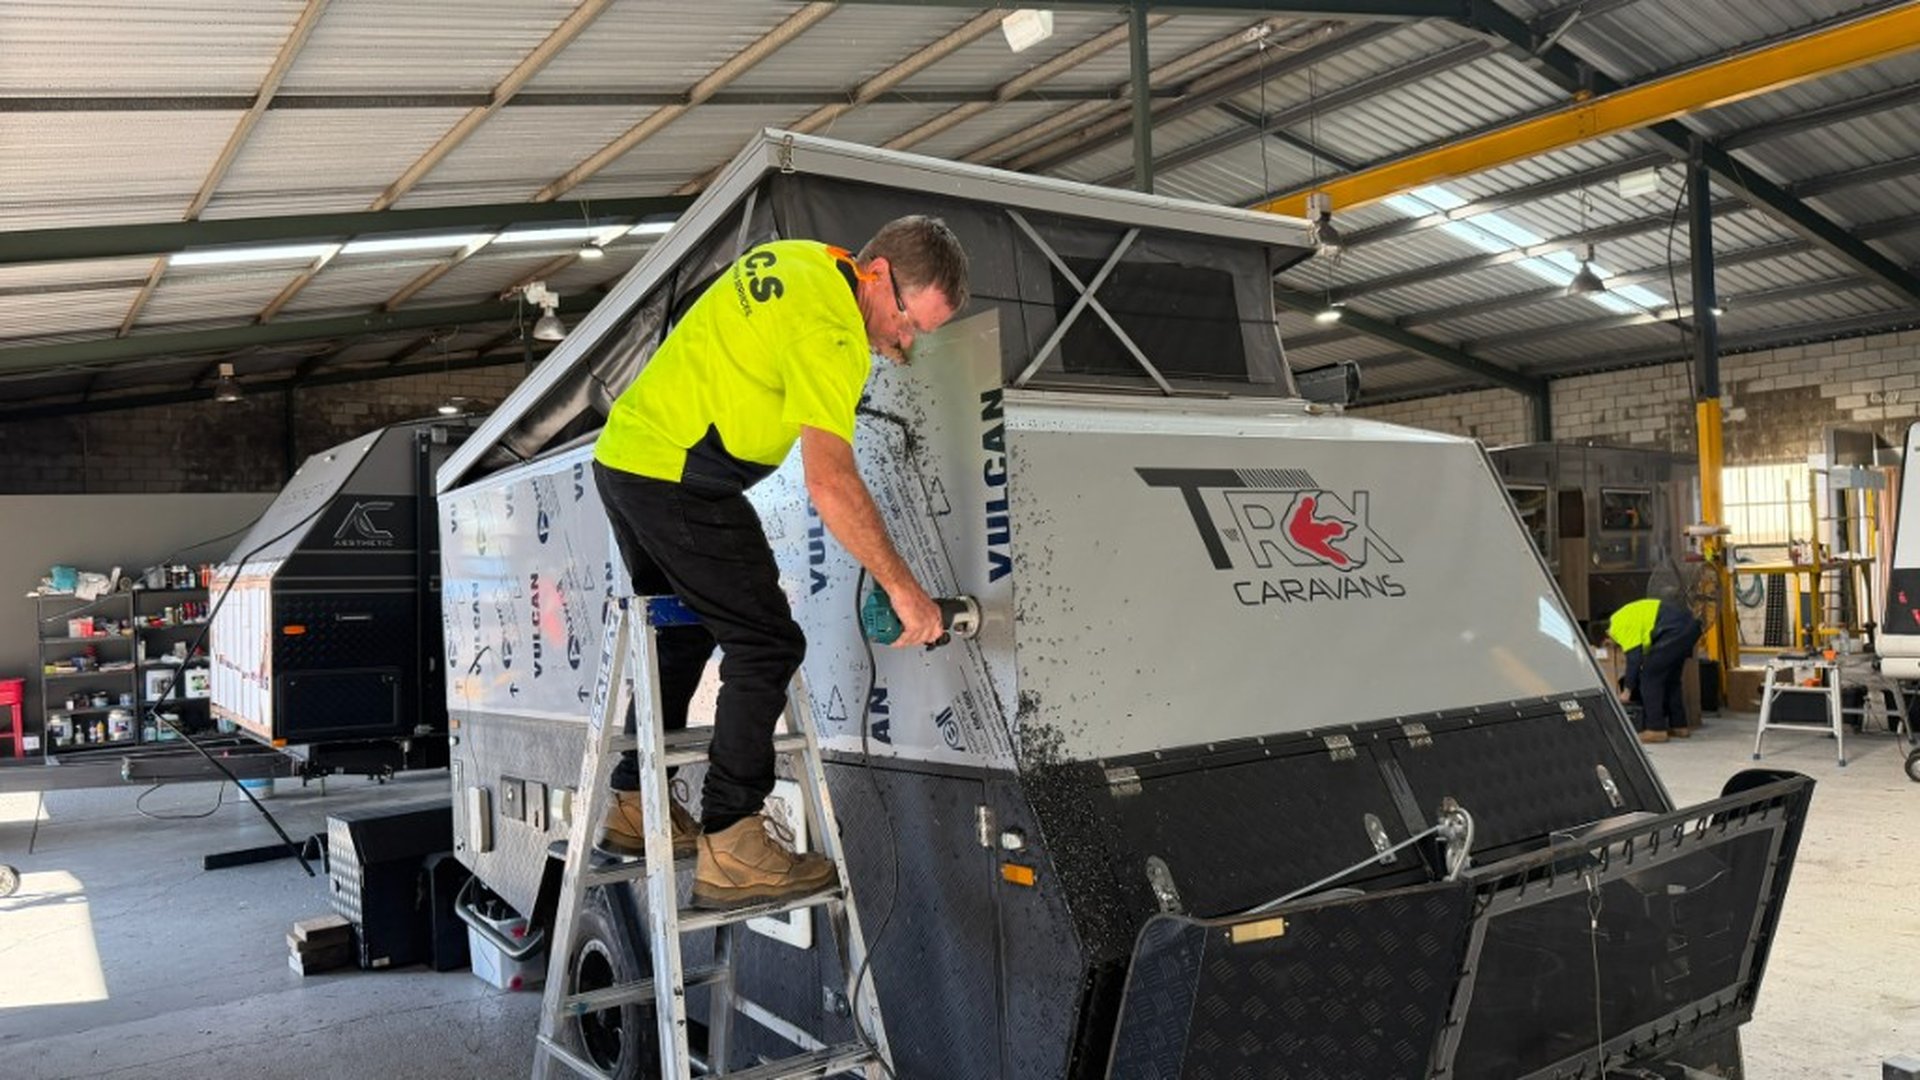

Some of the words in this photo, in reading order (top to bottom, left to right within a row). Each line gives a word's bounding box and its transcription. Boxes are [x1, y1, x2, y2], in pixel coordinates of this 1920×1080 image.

[981, 388, 1013, 583] VULCAN
[472, 582, 482, 675] VULCAN
[530, 573, 543, 679] VULCAN
[1233, 575, 1405, 605] CARAVANS
